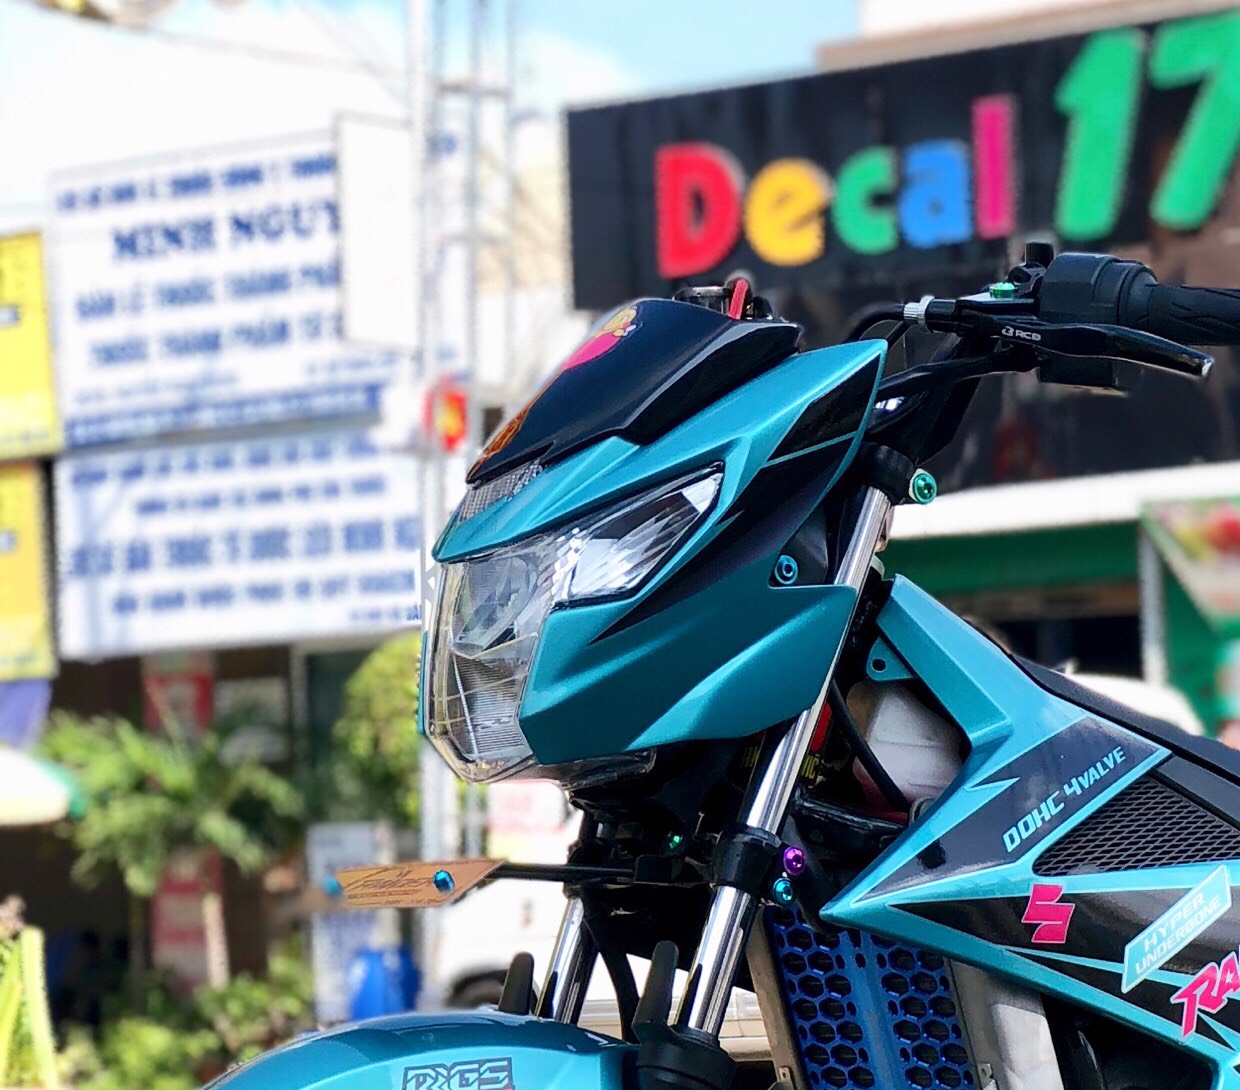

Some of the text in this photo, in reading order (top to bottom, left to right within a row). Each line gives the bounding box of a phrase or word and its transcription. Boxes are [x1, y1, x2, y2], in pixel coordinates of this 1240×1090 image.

[655, 95, 1017, 280] Decal
[1002, 790, 1065, 853] DOHC
[1135, 894, 1221, 975] UNDERBONE
[1144, 892, 1205, 952] HYPER
